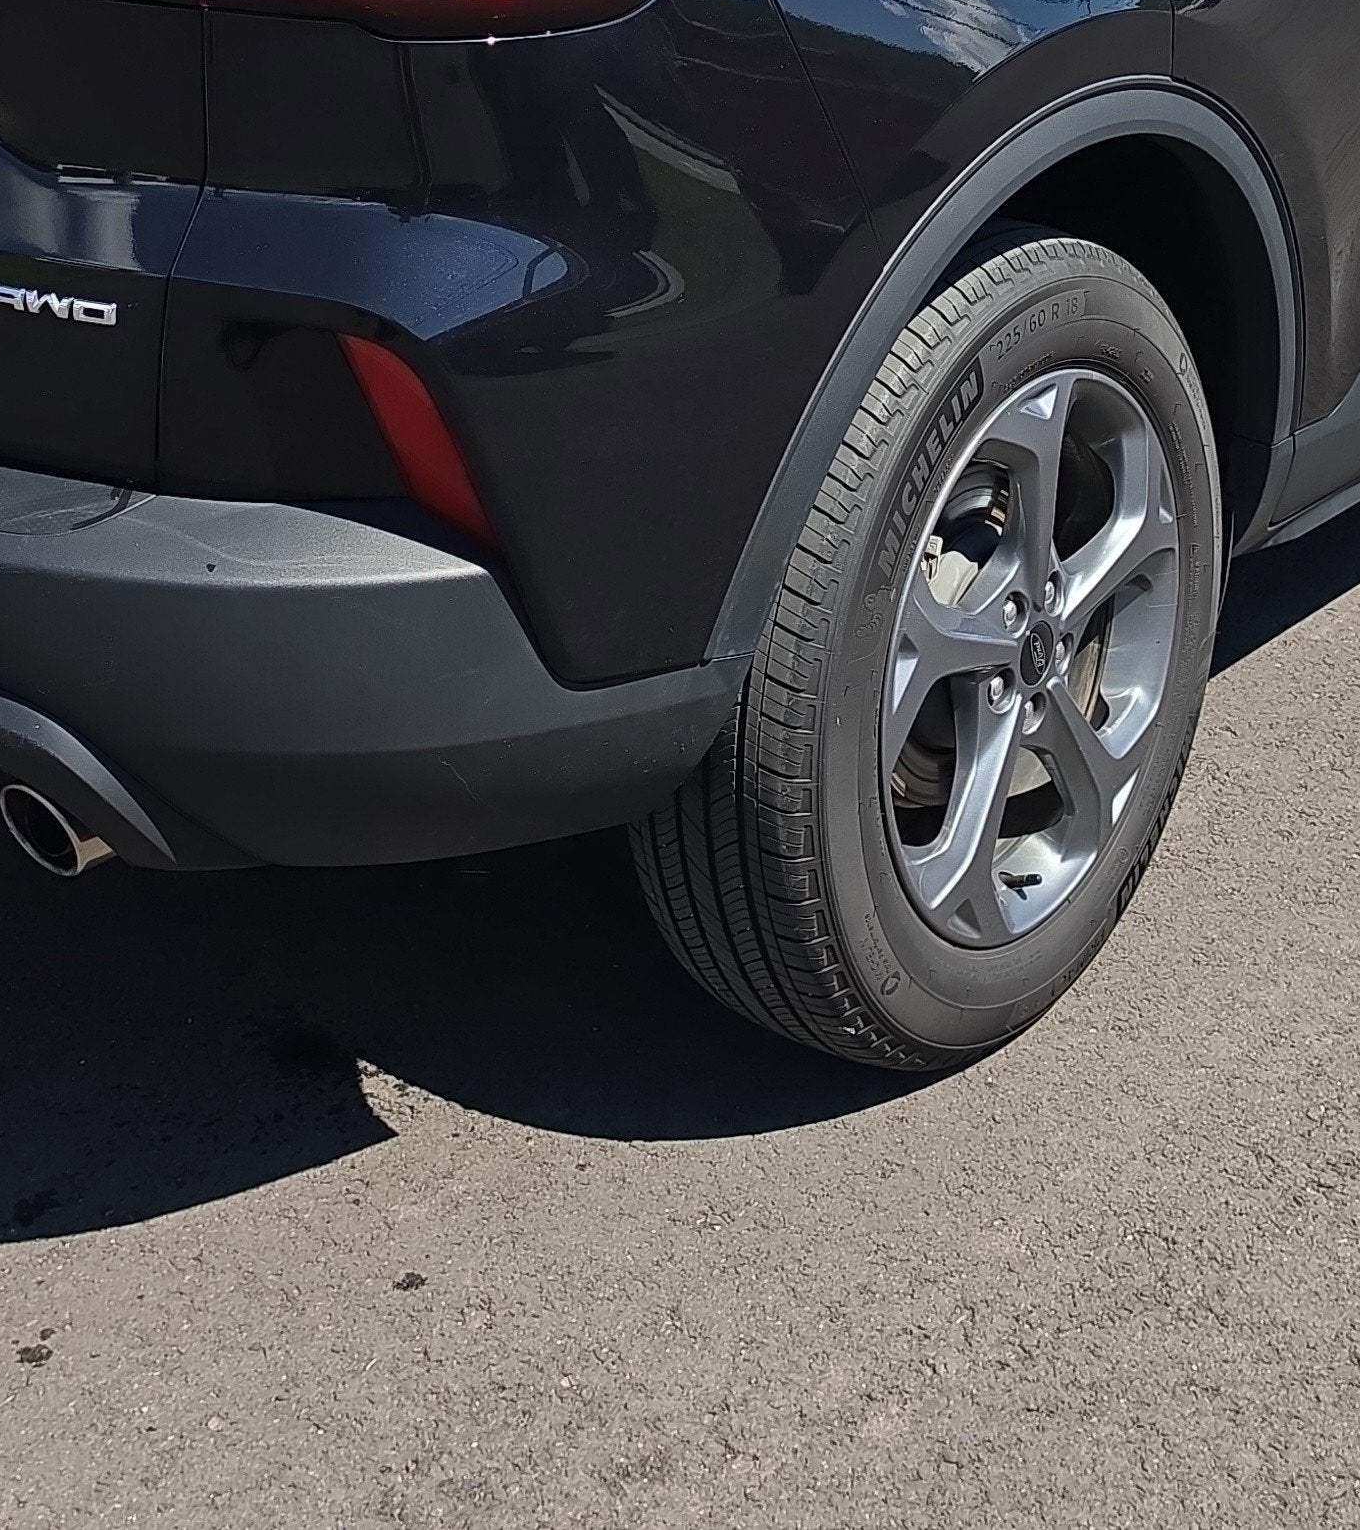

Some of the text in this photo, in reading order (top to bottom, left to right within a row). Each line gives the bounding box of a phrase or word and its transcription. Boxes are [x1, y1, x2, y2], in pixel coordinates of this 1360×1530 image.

[995, 308, 1046, 363] 225/60
[1065, 297, 1079, 317] 18
[878, 369, 982, 581] MICHELIN
